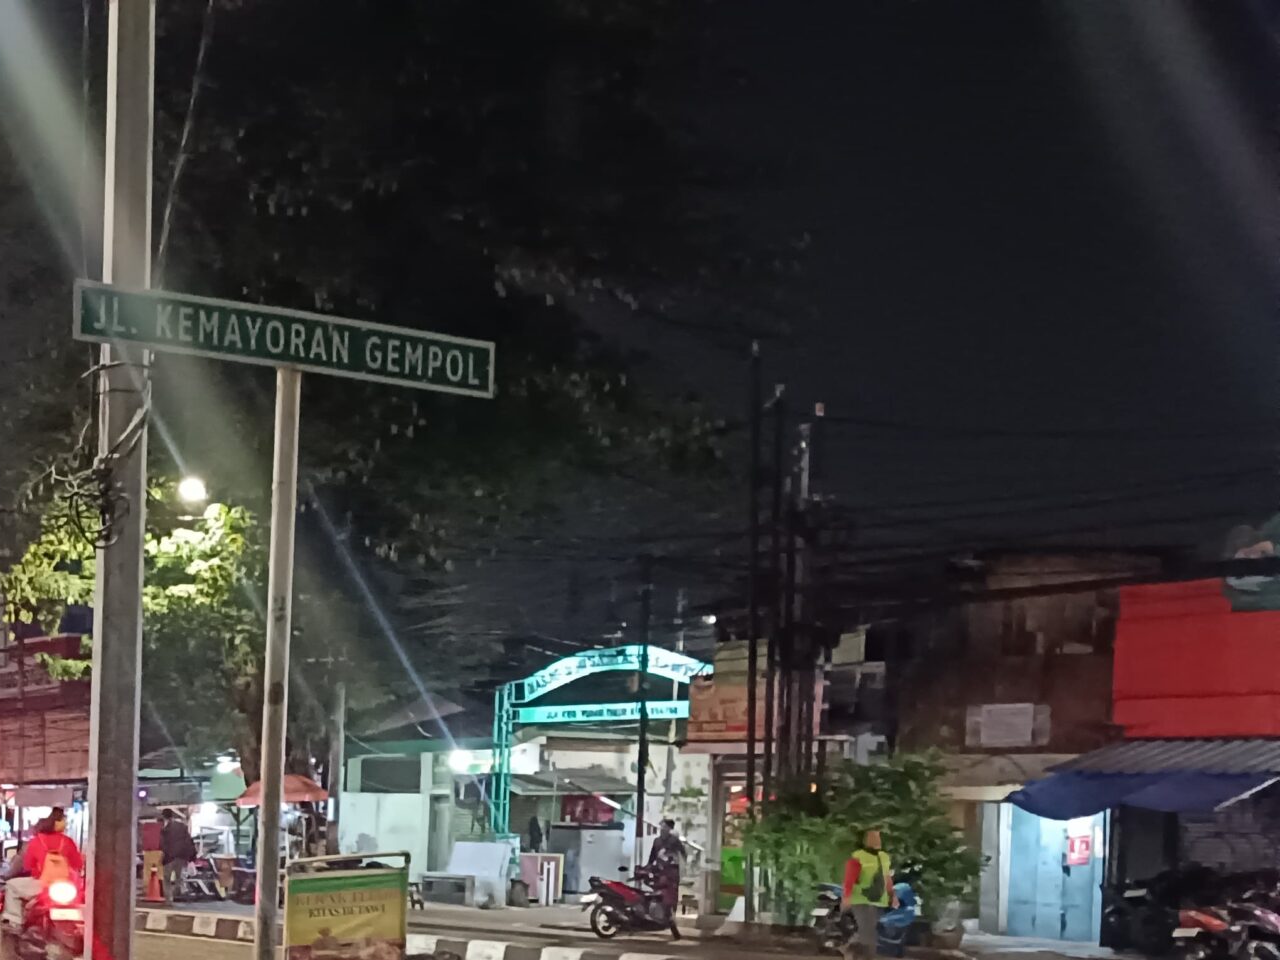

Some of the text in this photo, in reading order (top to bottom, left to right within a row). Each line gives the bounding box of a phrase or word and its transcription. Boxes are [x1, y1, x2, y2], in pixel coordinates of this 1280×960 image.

[93, 296, 481, 387] JL. KEMAYORAN GEMPOL
